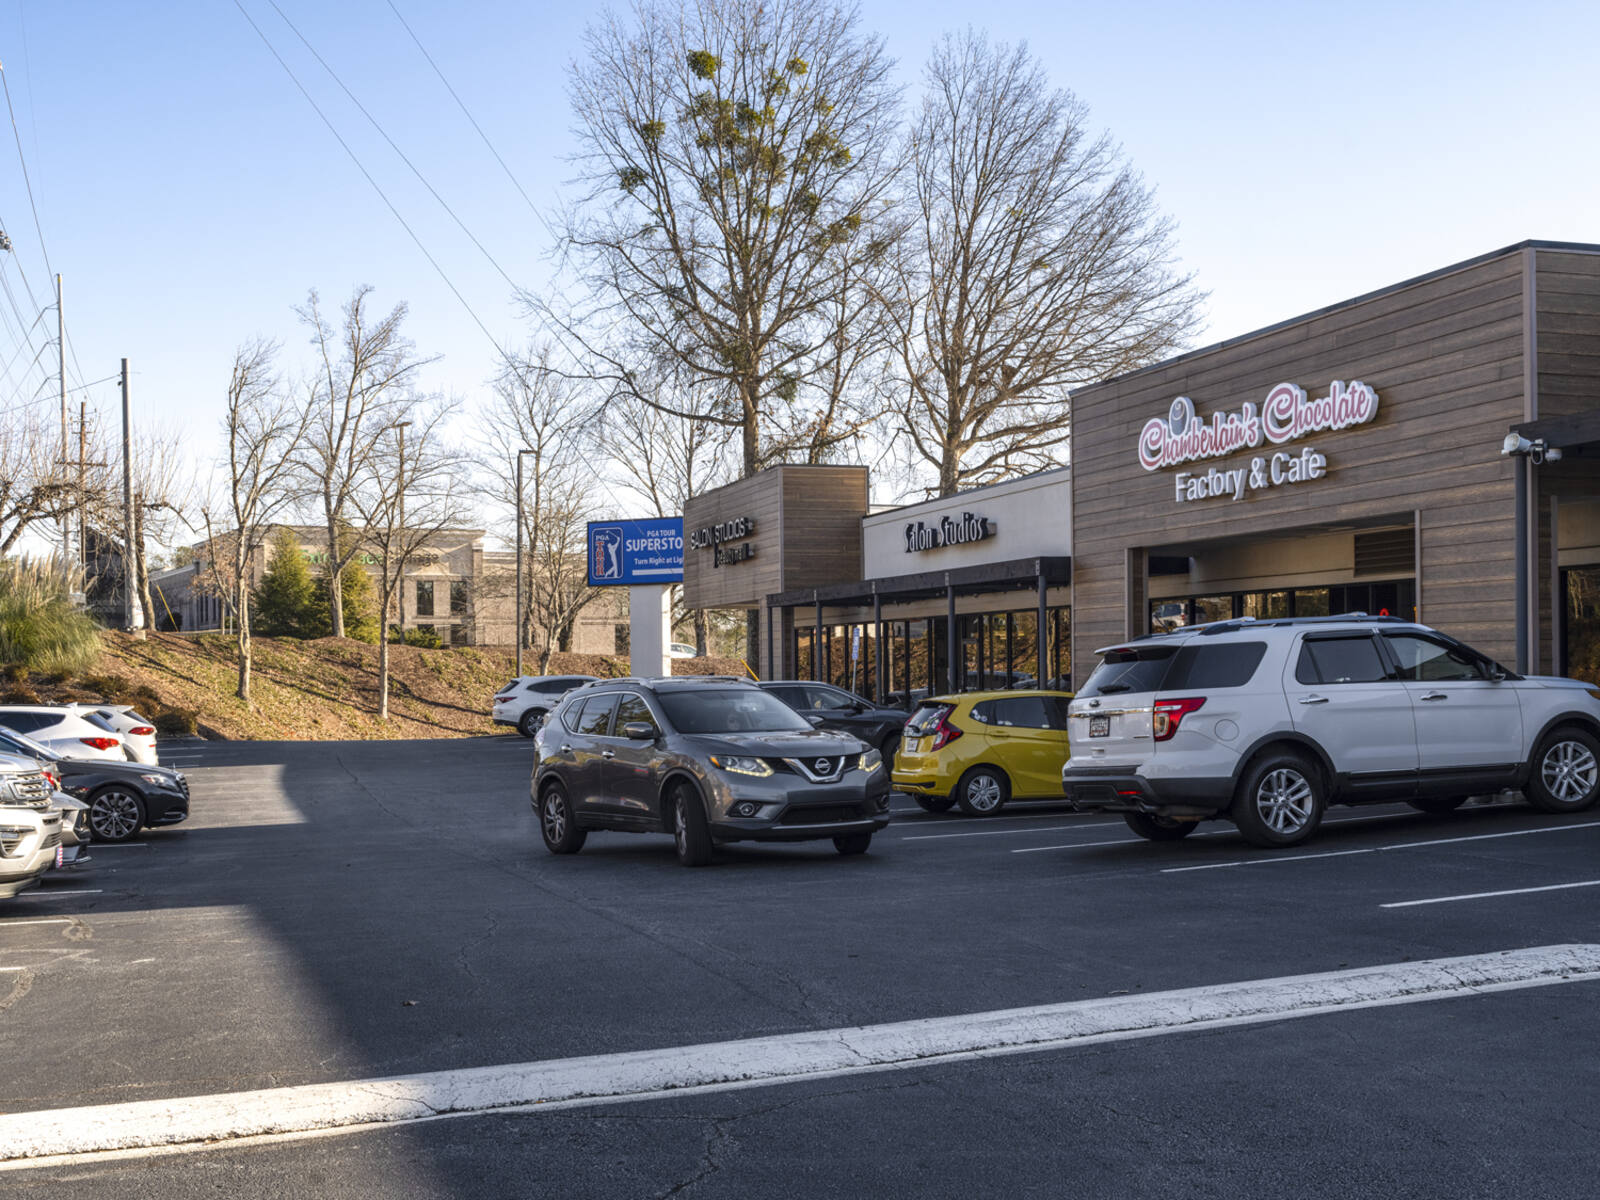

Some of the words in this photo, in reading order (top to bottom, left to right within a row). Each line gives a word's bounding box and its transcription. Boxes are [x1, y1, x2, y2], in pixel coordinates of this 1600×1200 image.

[1139, 402, 1258, 471] Chamberlain's
[1262, 380, 1378, 443] Chocolate
[1175, 467, 1246, 502] Factory
[1250, 457, 1268, 489] &
[1271, 447, 1326, 485] Cafe
[690, 528, 713, 551] SALON
[714, 517, 746, 545] STUDIOS
[904, 522, 933, 553] Salon
[939, 512, 983, 547] Studios
[634, 557, 648, 565] Turn
[648, 556, 665, 566] Right
